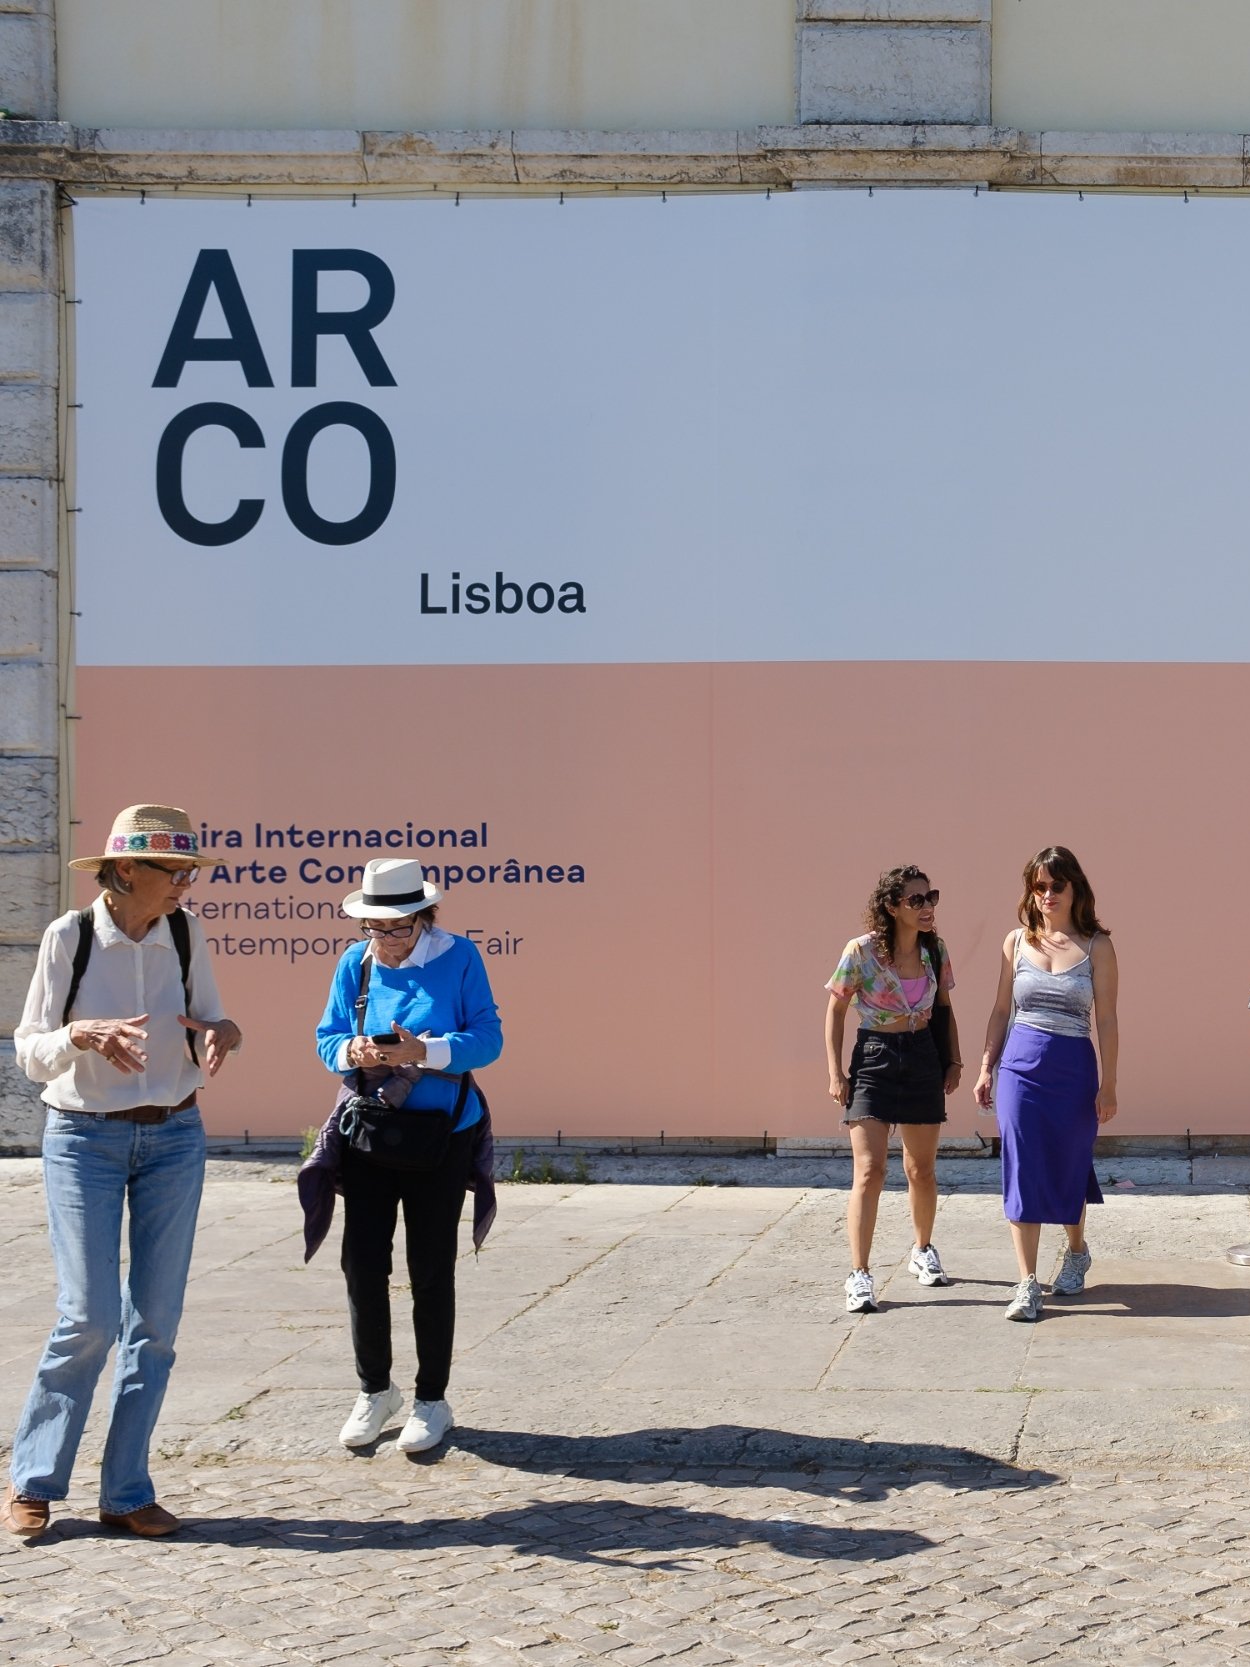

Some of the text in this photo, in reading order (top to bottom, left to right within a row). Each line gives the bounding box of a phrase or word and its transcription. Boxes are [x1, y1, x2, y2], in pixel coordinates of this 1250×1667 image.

[151, 248, 398, 388] AR
[156, 401, 396, 546] CO
[420, 571, 587, 614] Lisboa
[201, 822, 487, 848] ira Internacional
[209, 858, 585, 890] Arte Conmporânea
[466, 930, 523, 954] Fair
